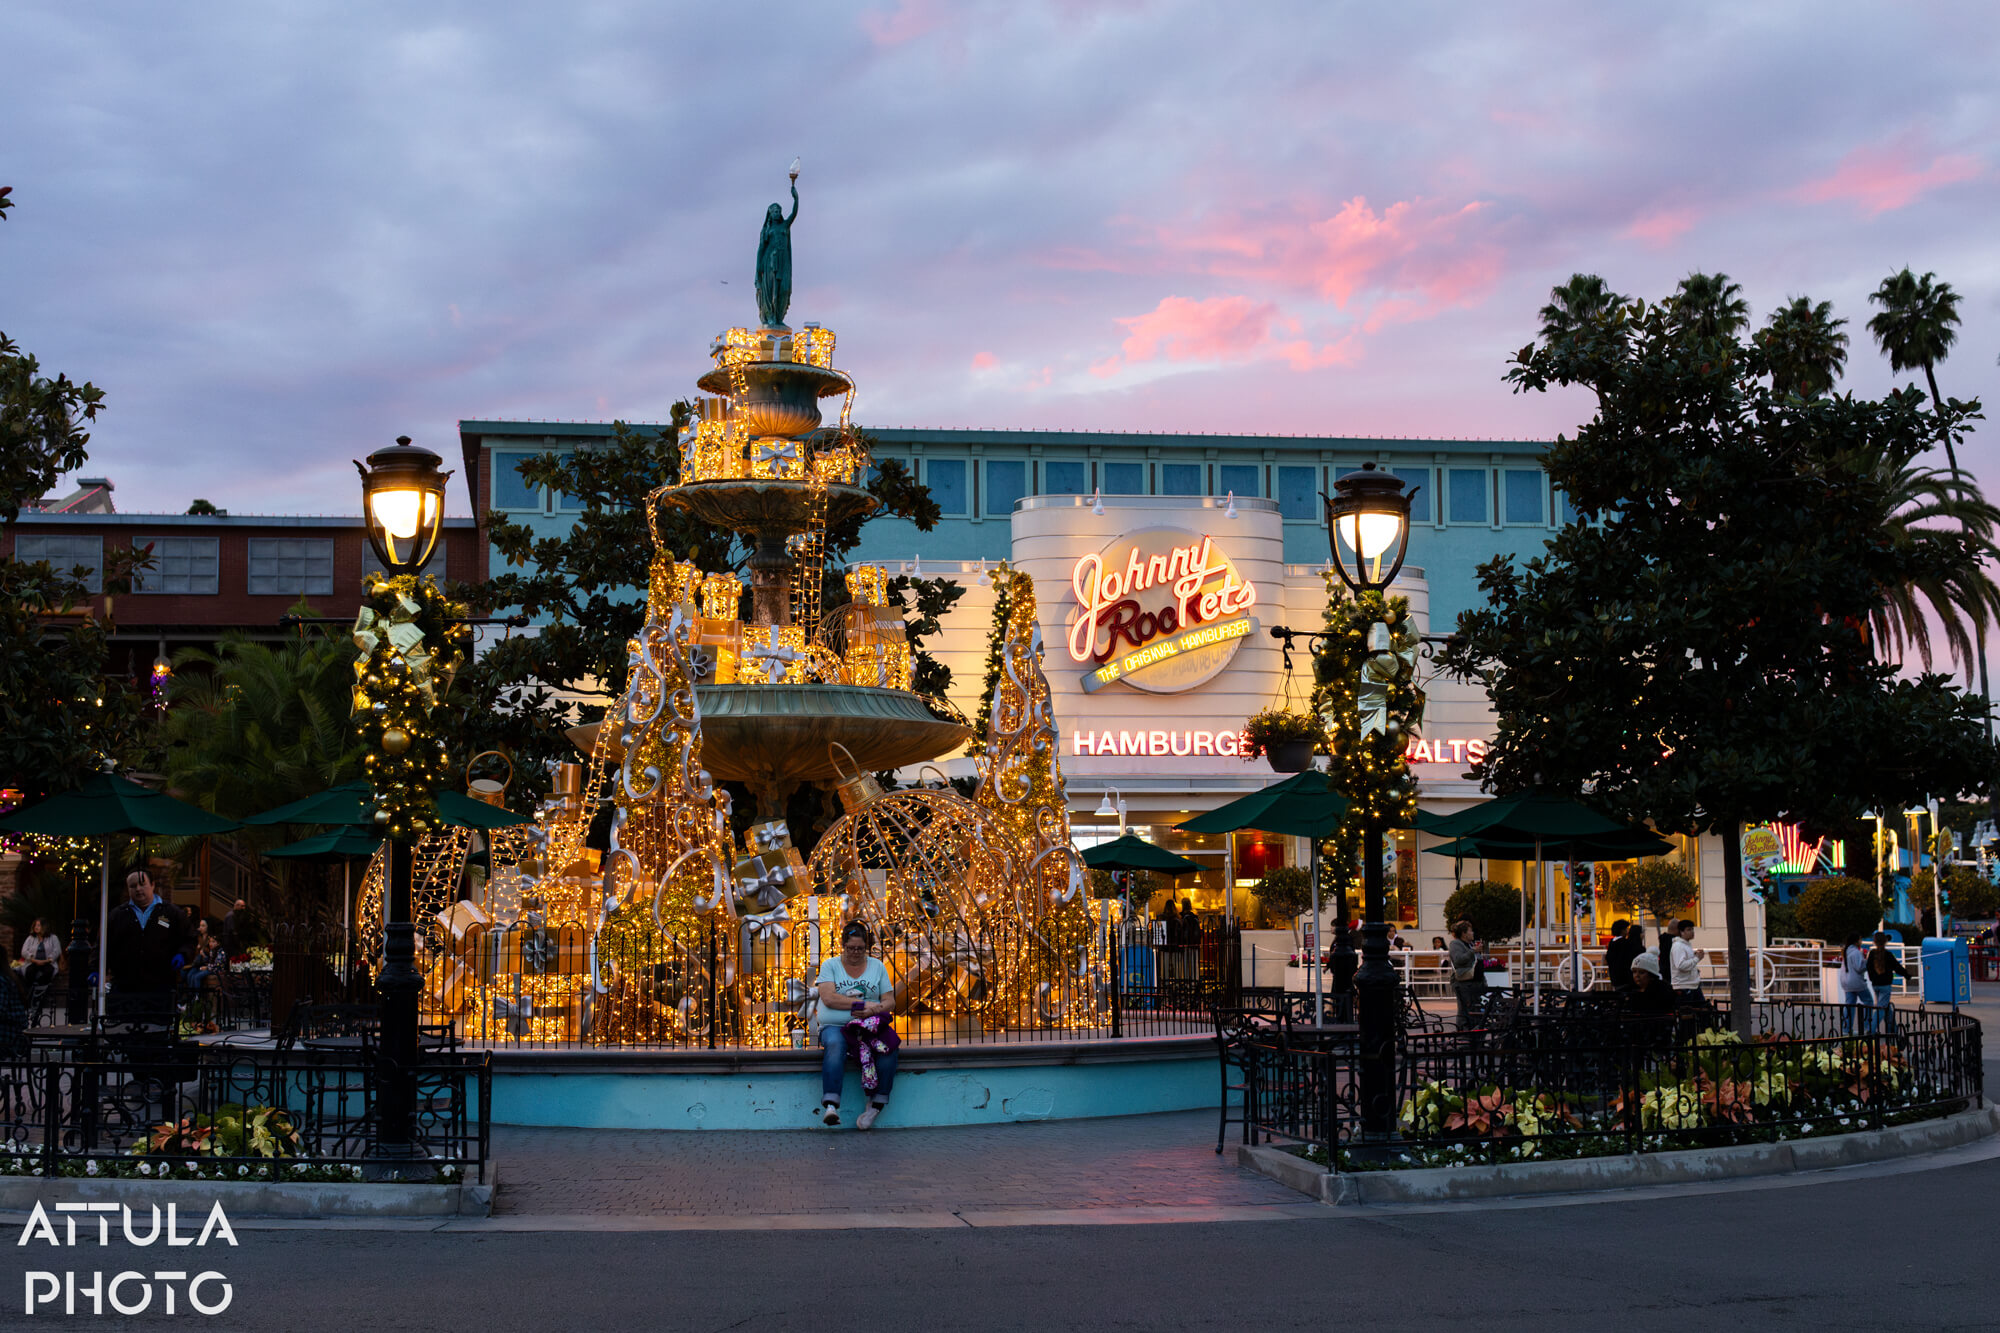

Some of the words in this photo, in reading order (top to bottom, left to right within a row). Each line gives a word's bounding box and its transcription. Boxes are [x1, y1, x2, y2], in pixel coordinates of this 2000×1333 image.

[1069, 534, 1228, 661] Johnny
[1097, 664, 1121, 683] THE
[1124, 641, 1179, 672] ORIGINAL
[1180, 619, 1251, 651] HAMBURGER
[1073, 730, 1267, 757] HAMBURGE
[834, 979, 878, 993] SNUGGLE
